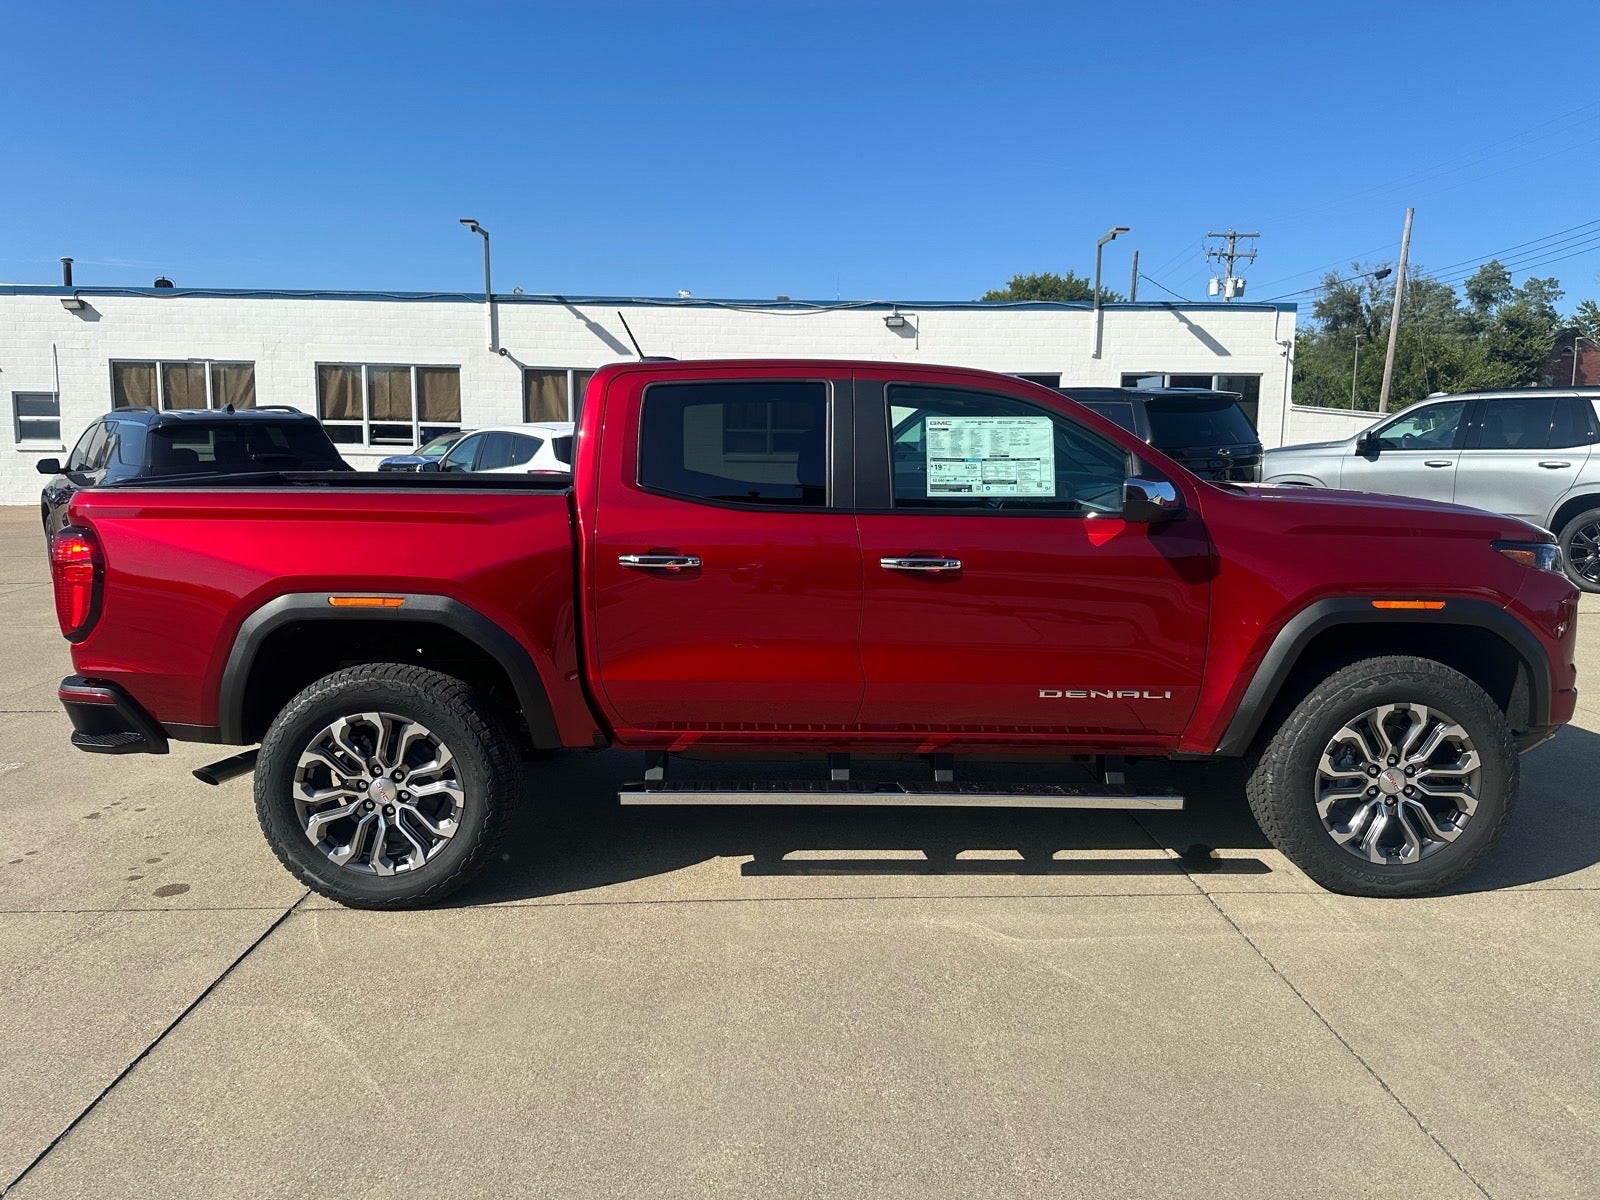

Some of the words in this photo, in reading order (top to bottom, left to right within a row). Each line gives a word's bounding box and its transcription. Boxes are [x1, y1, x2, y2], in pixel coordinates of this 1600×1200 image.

[1039, 689, 1171, 699] DENALI
[1386, 771, 1400, 791] GMC
[375, 781, 389, 802] GMC
